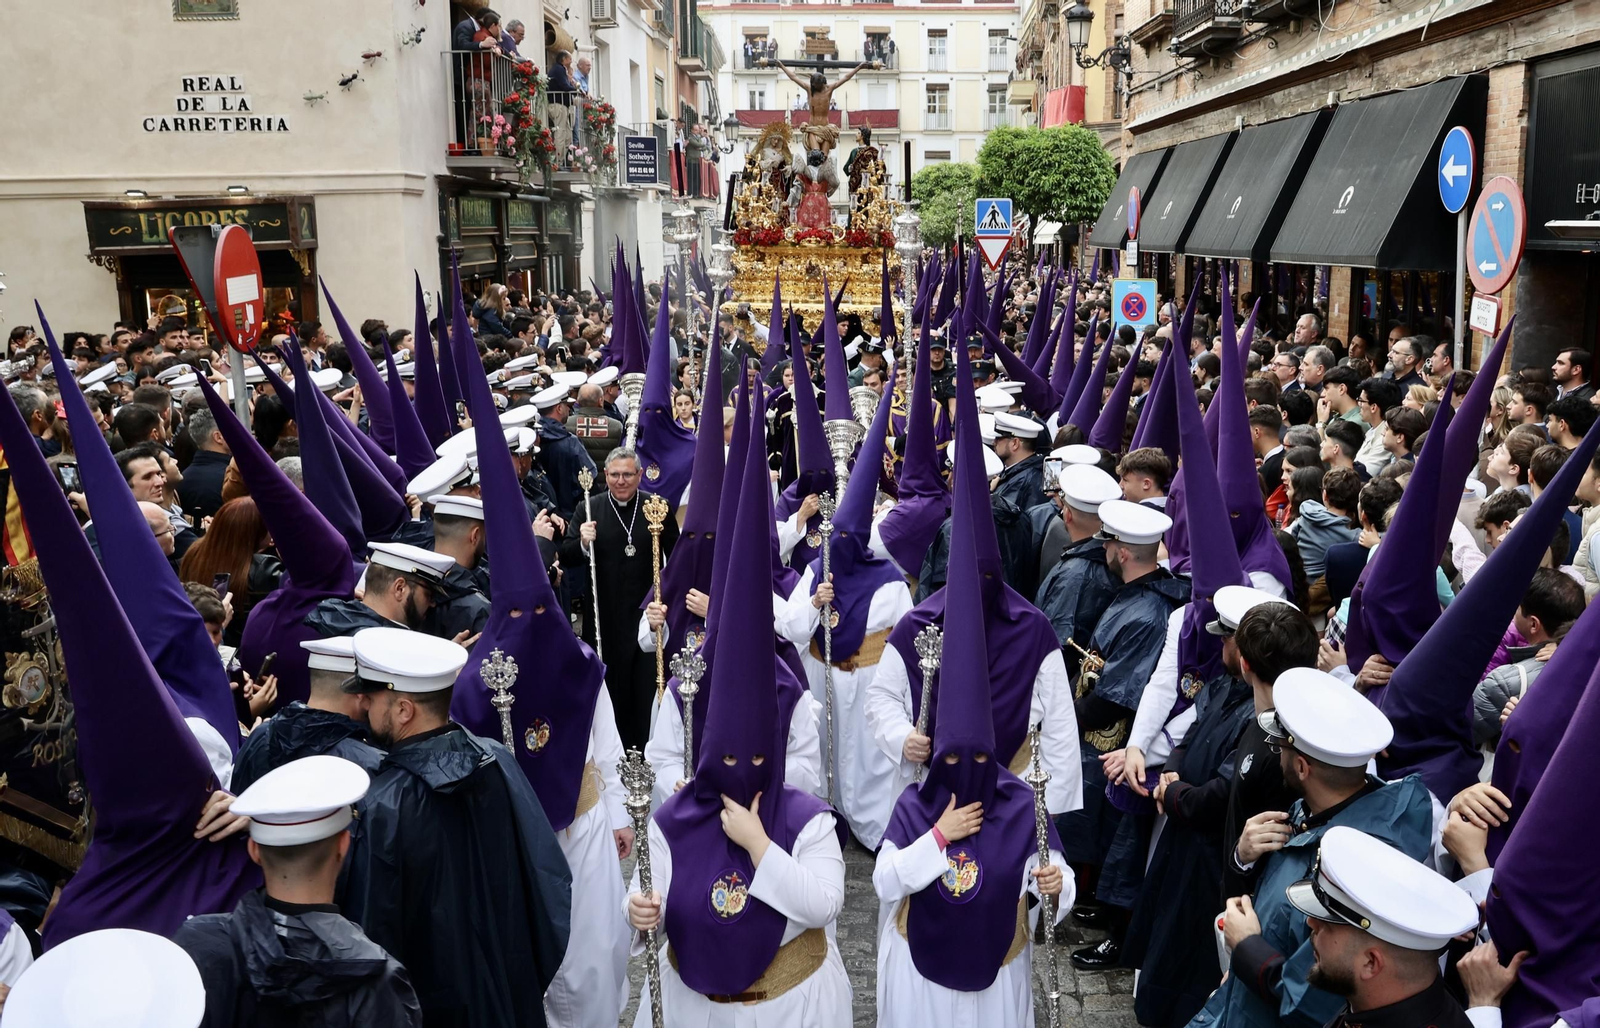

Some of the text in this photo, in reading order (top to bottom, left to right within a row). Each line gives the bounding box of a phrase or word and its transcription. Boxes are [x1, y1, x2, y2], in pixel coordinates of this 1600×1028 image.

[182, 76, 242, 92] REAL
[176, 97, 250, 112] DE LA
[143, 117, 289, 131] CARRETERIA
[628, 153, 655, 162] Sotheby's
[301, 207, 310, 238] 2
